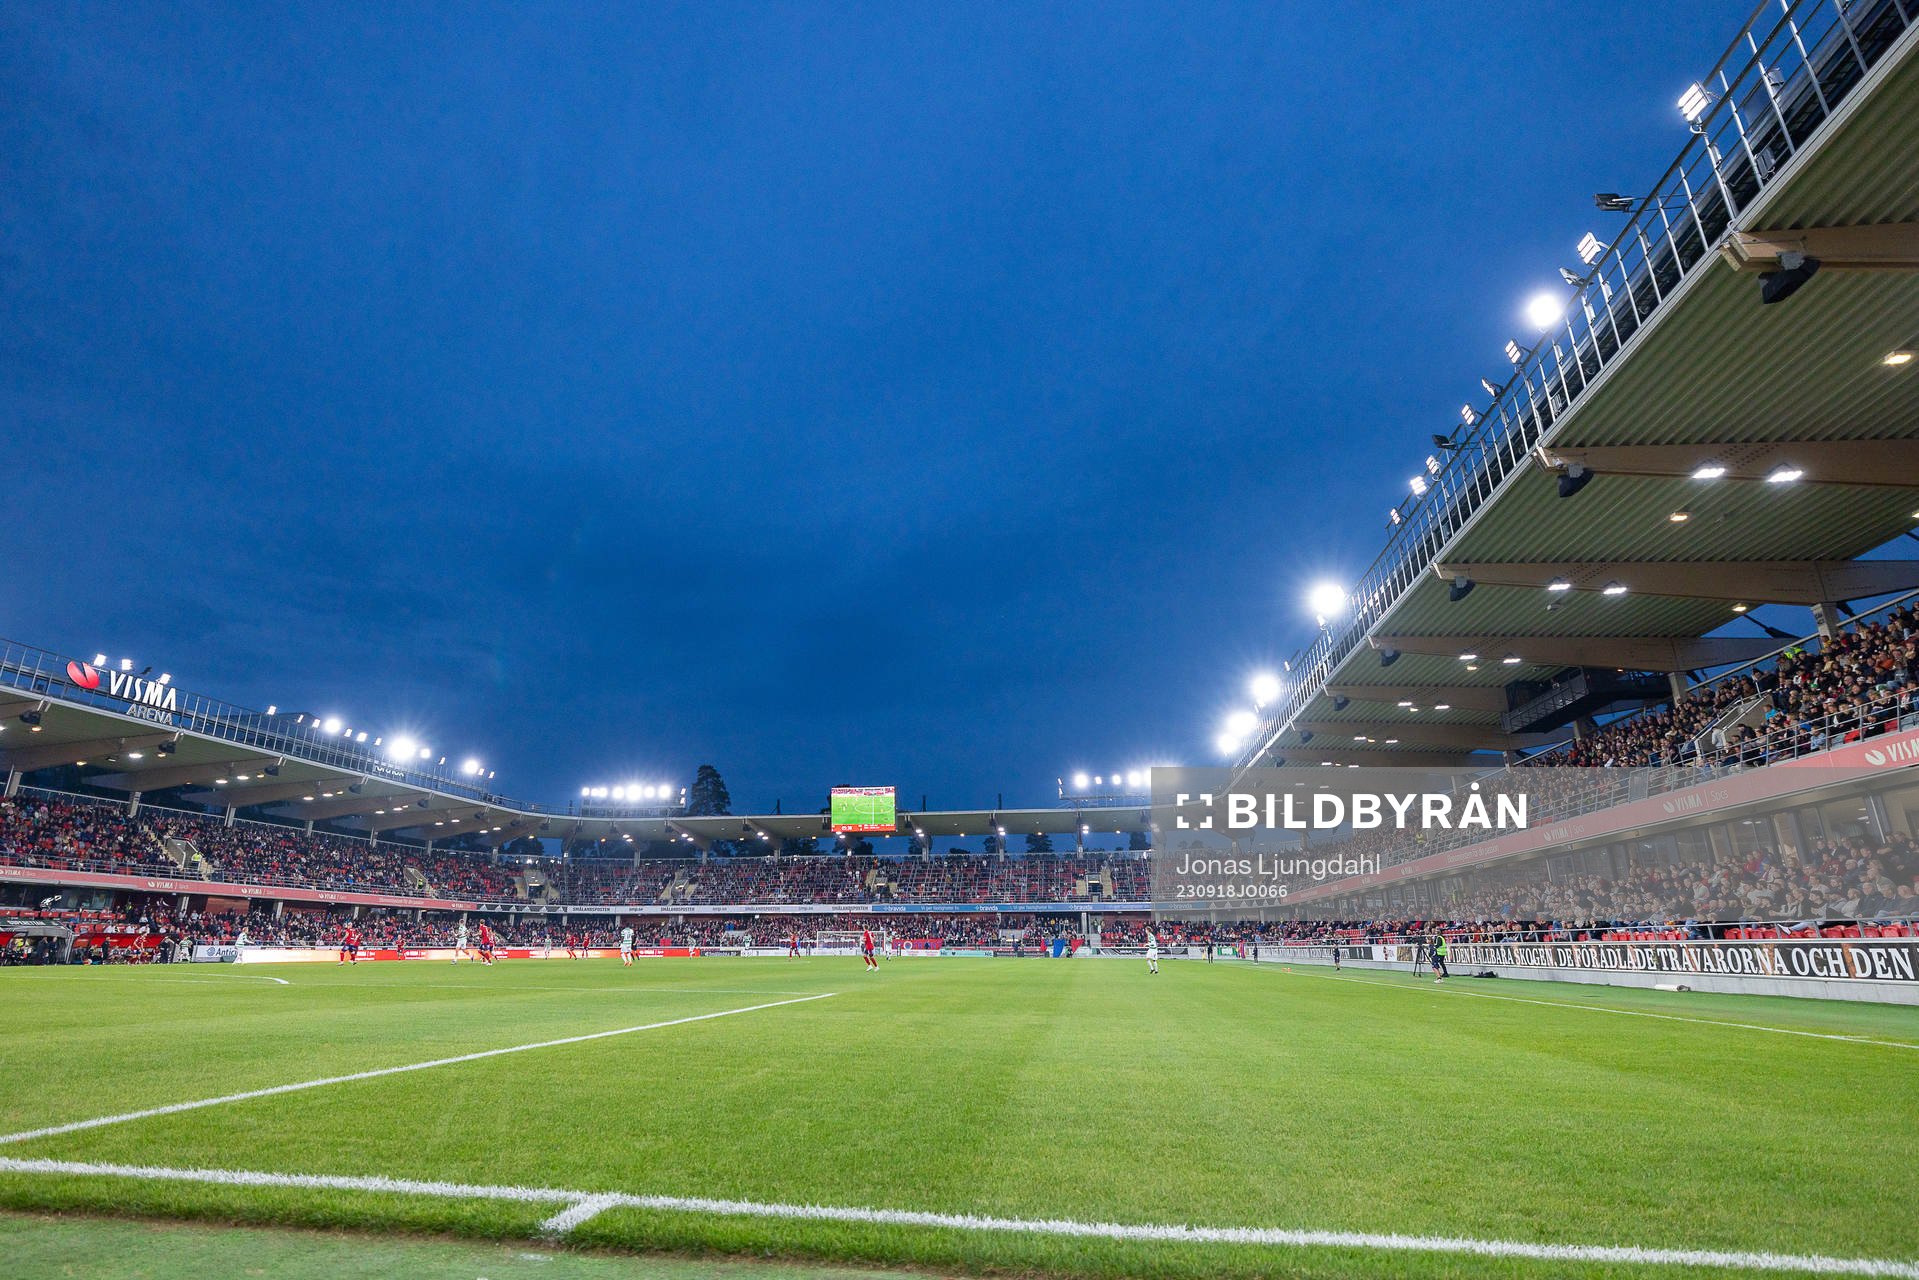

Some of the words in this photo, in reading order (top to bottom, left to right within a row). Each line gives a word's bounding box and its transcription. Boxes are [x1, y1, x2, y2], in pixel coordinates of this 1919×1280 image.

[110, 670, 176, 711] VISMA
[126, 704, 173, 726] ARENA
[1886, 737, 1919, 762] VISM
[1674, 792, 1703, 812] VISMA
[1557, 948, 1574, 967] DE
[1791, 947, 1849, 977] OCH
[1848, 948, 1915, 980] DEN
